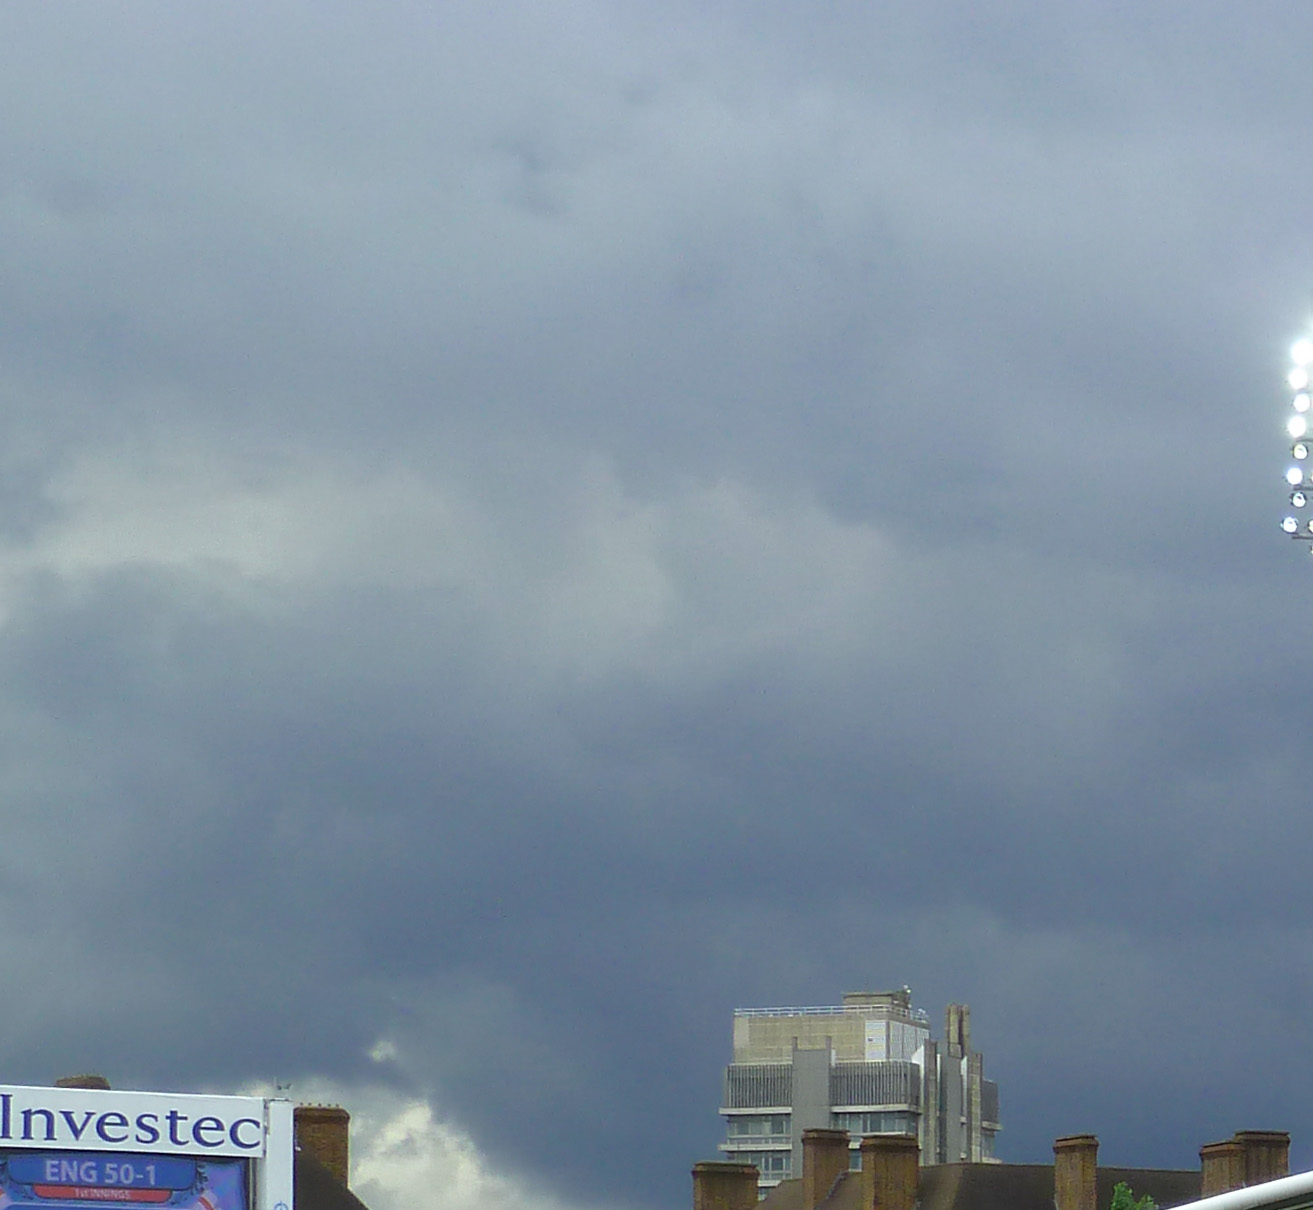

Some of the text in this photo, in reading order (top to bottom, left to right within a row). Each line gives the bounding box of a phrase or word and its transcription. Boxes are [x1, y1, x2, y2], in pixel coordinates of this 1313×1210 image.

[0, 1094, 262, 1150] Investec
[45, 1160, 157, 1186] ENG 50-1
